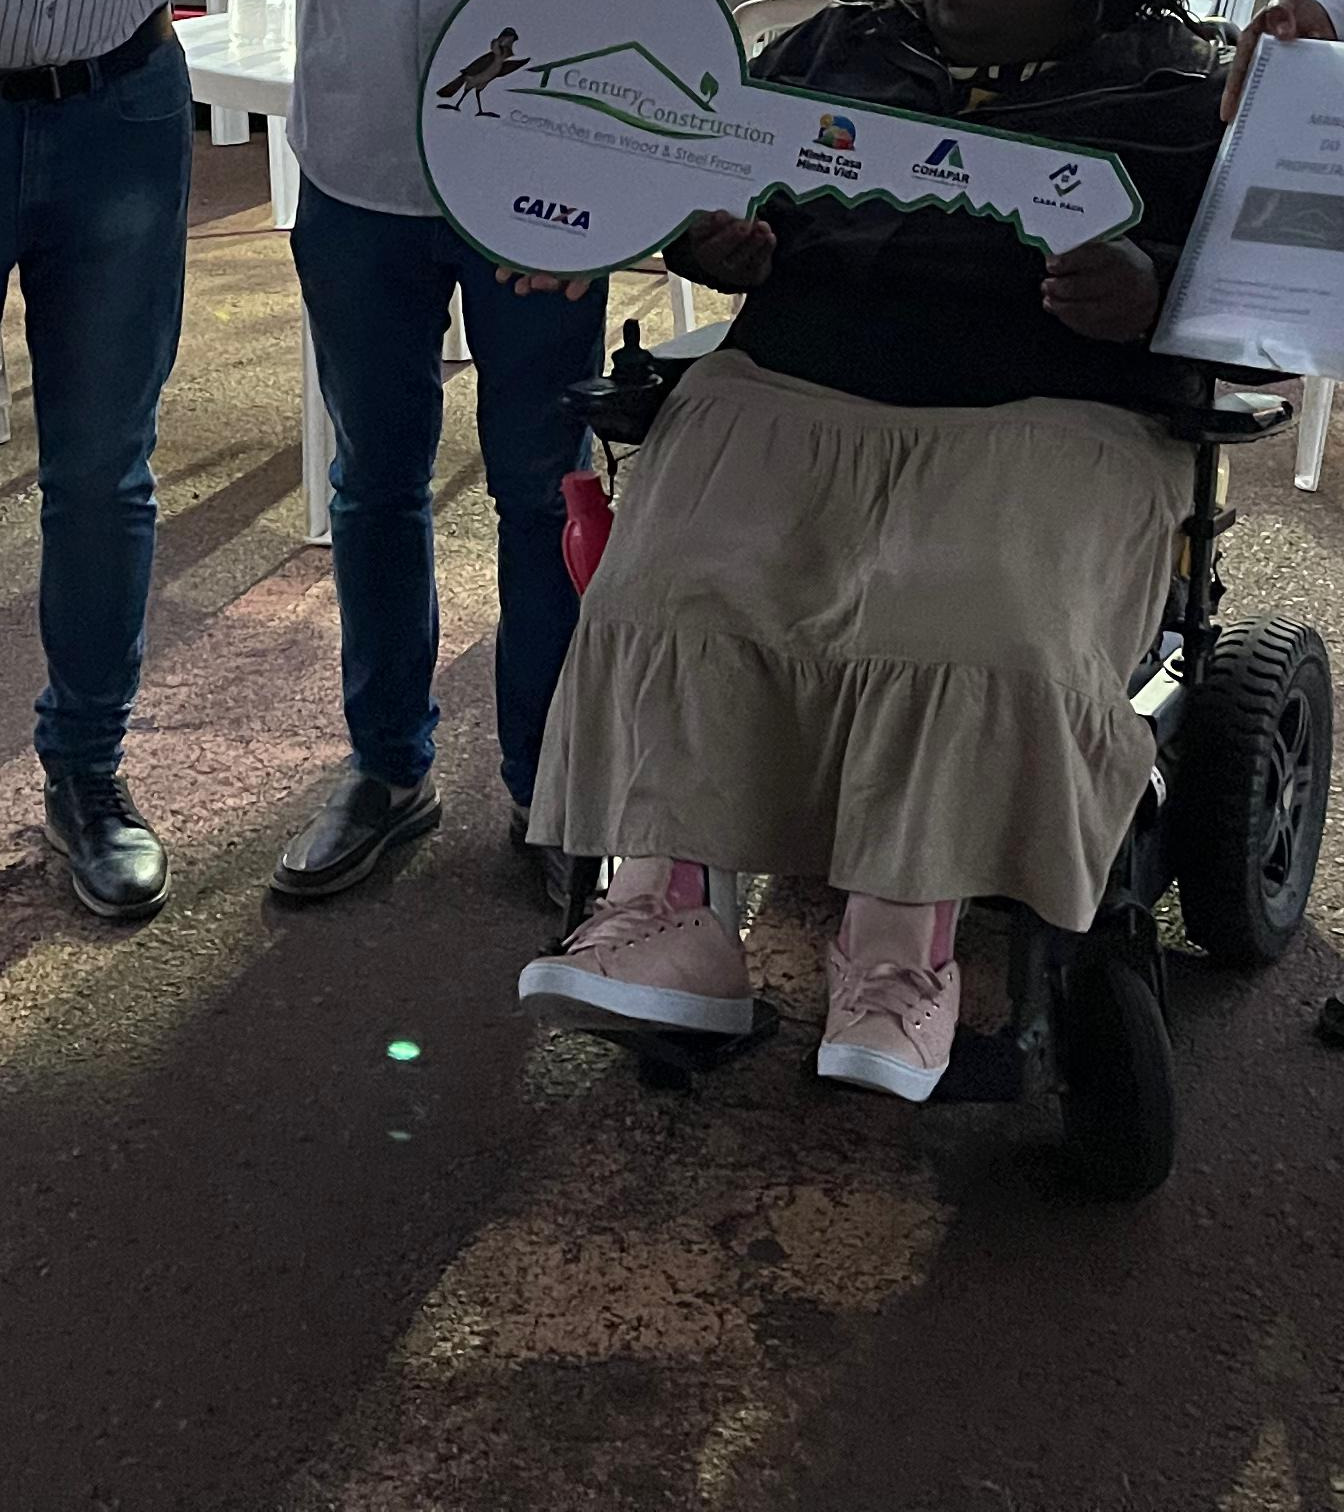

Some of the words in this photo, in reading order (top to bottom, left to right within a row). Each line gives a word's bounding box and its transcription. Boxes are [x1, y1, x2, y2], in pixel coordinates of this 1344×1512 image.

[563, 69, 642, 106] Century
[637, 97, 775, 146] Construction
[619, 135, 659, 154] Wood
[675, 147, 708, 165] Steel
[710, 155, 752, 175] Frame
[798, 147, 833, 164] Minha
[835, 155, 862, 170] Casa
[1319, 138, 1342, 151] DO
[796, 158, 830, 174] Minha
[833, 166, 859, 180] Vida
[513, 195, 591, 230] CAIXA
